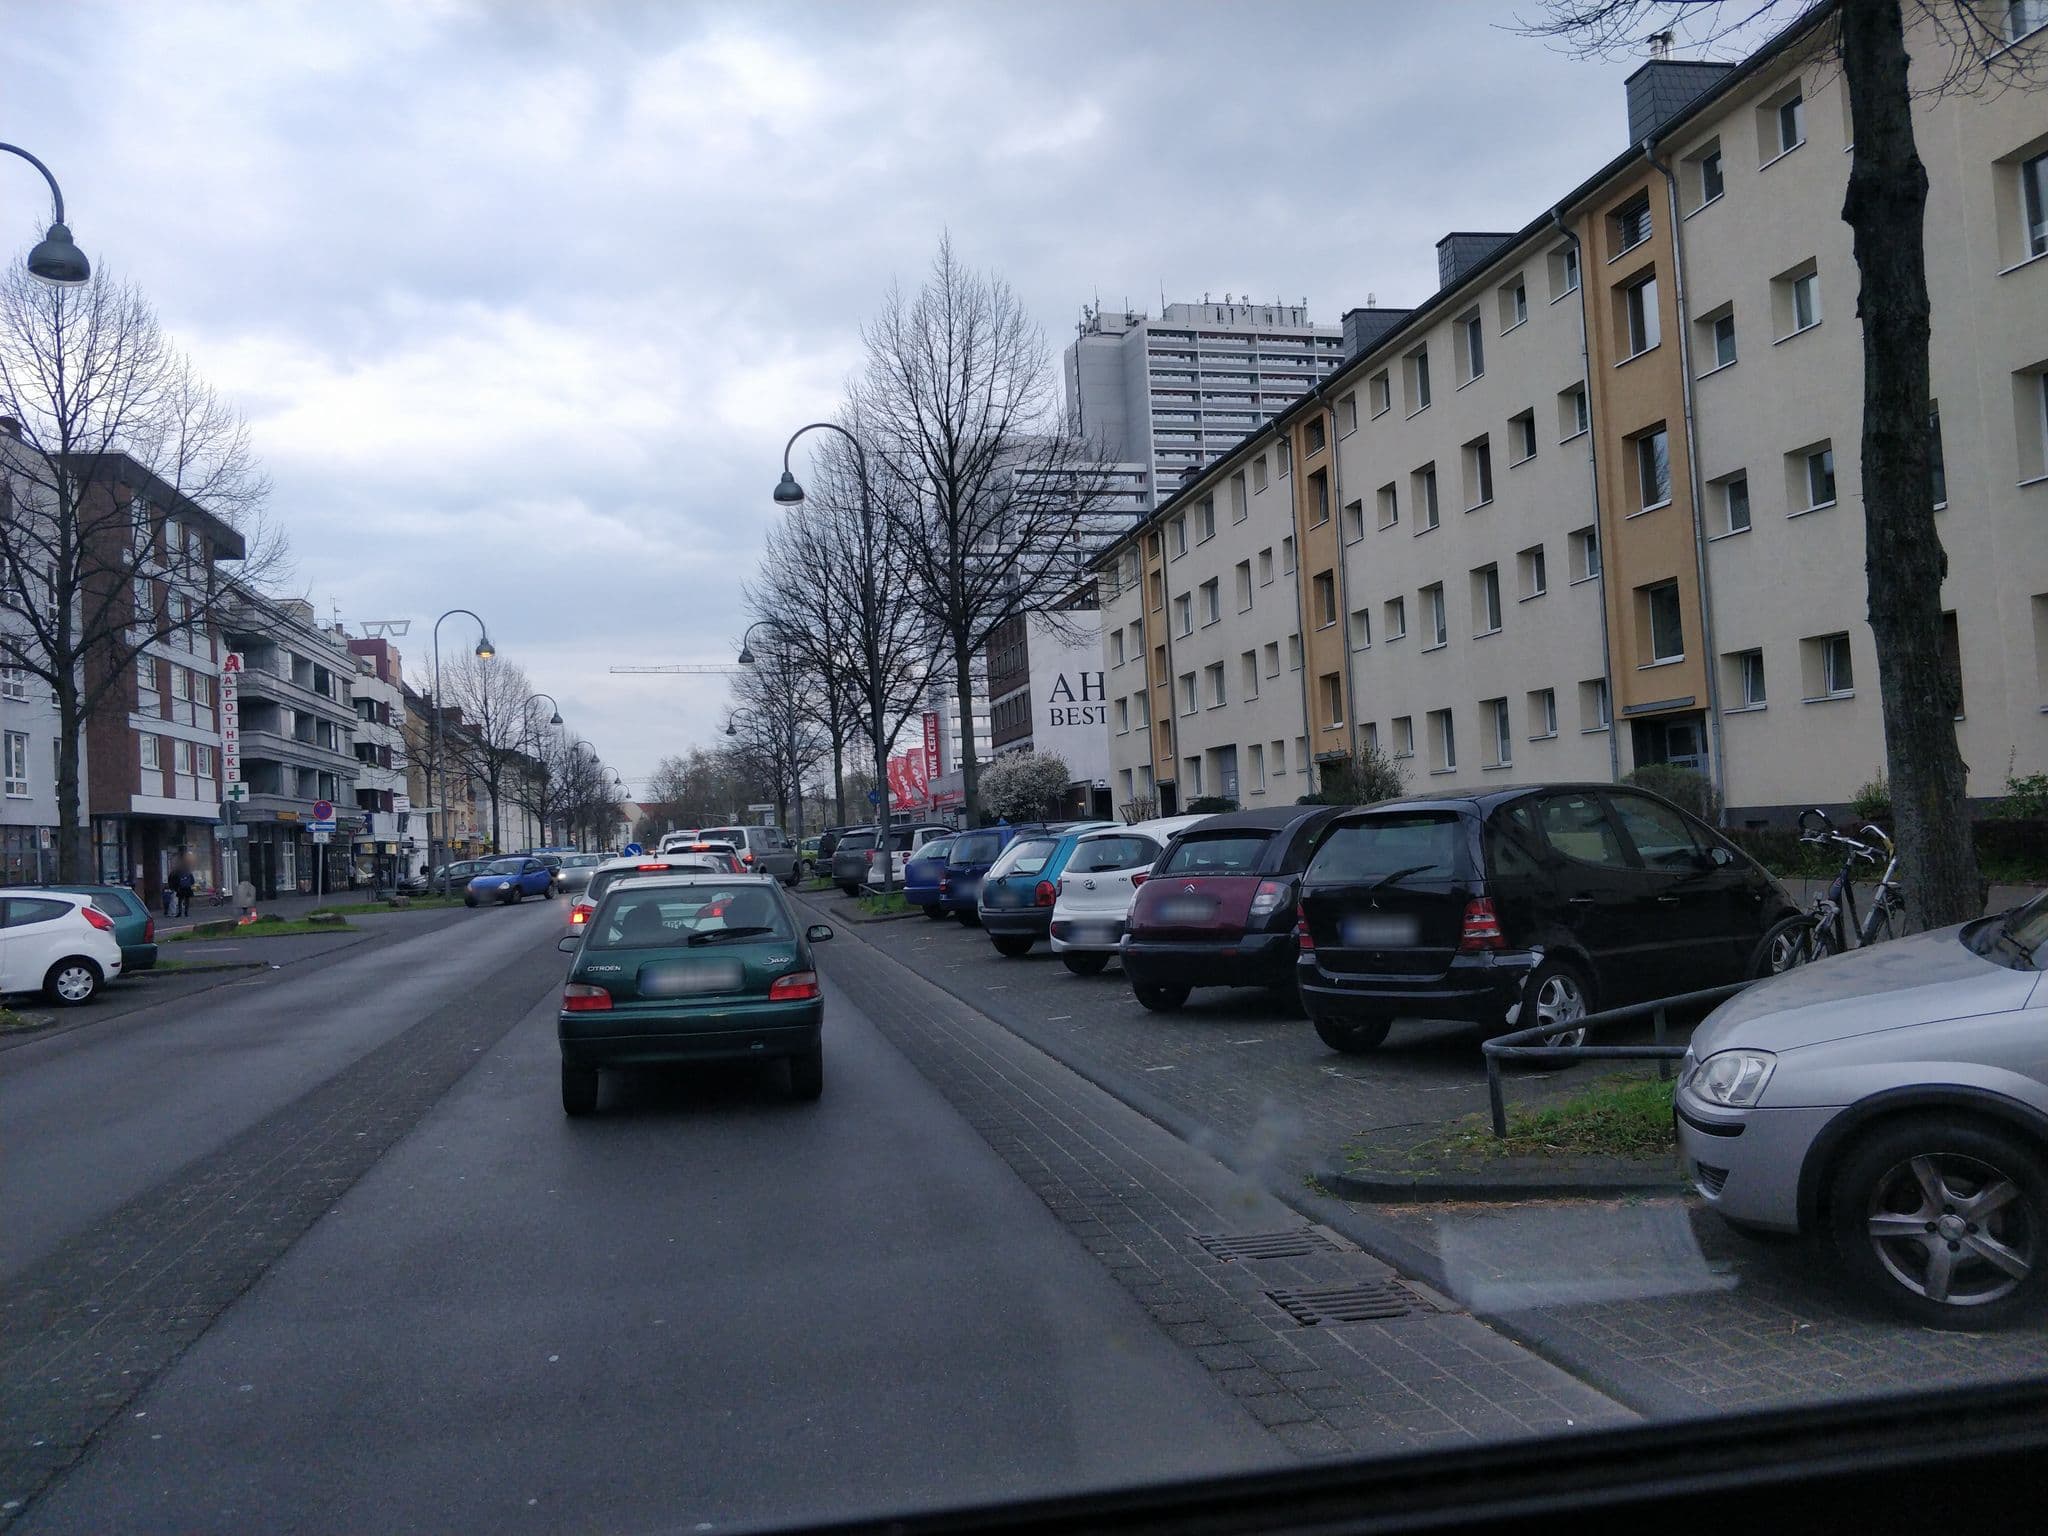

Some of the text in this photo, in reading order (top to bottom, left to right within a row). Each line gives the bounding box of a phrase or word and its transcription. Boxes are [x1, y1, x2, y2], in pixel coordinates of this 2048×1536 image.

[1048, 671, 1106, 703] AH
[224, 676, 235, 780] APOTHEKE
[1049, 705, 1107, 726] BEST
